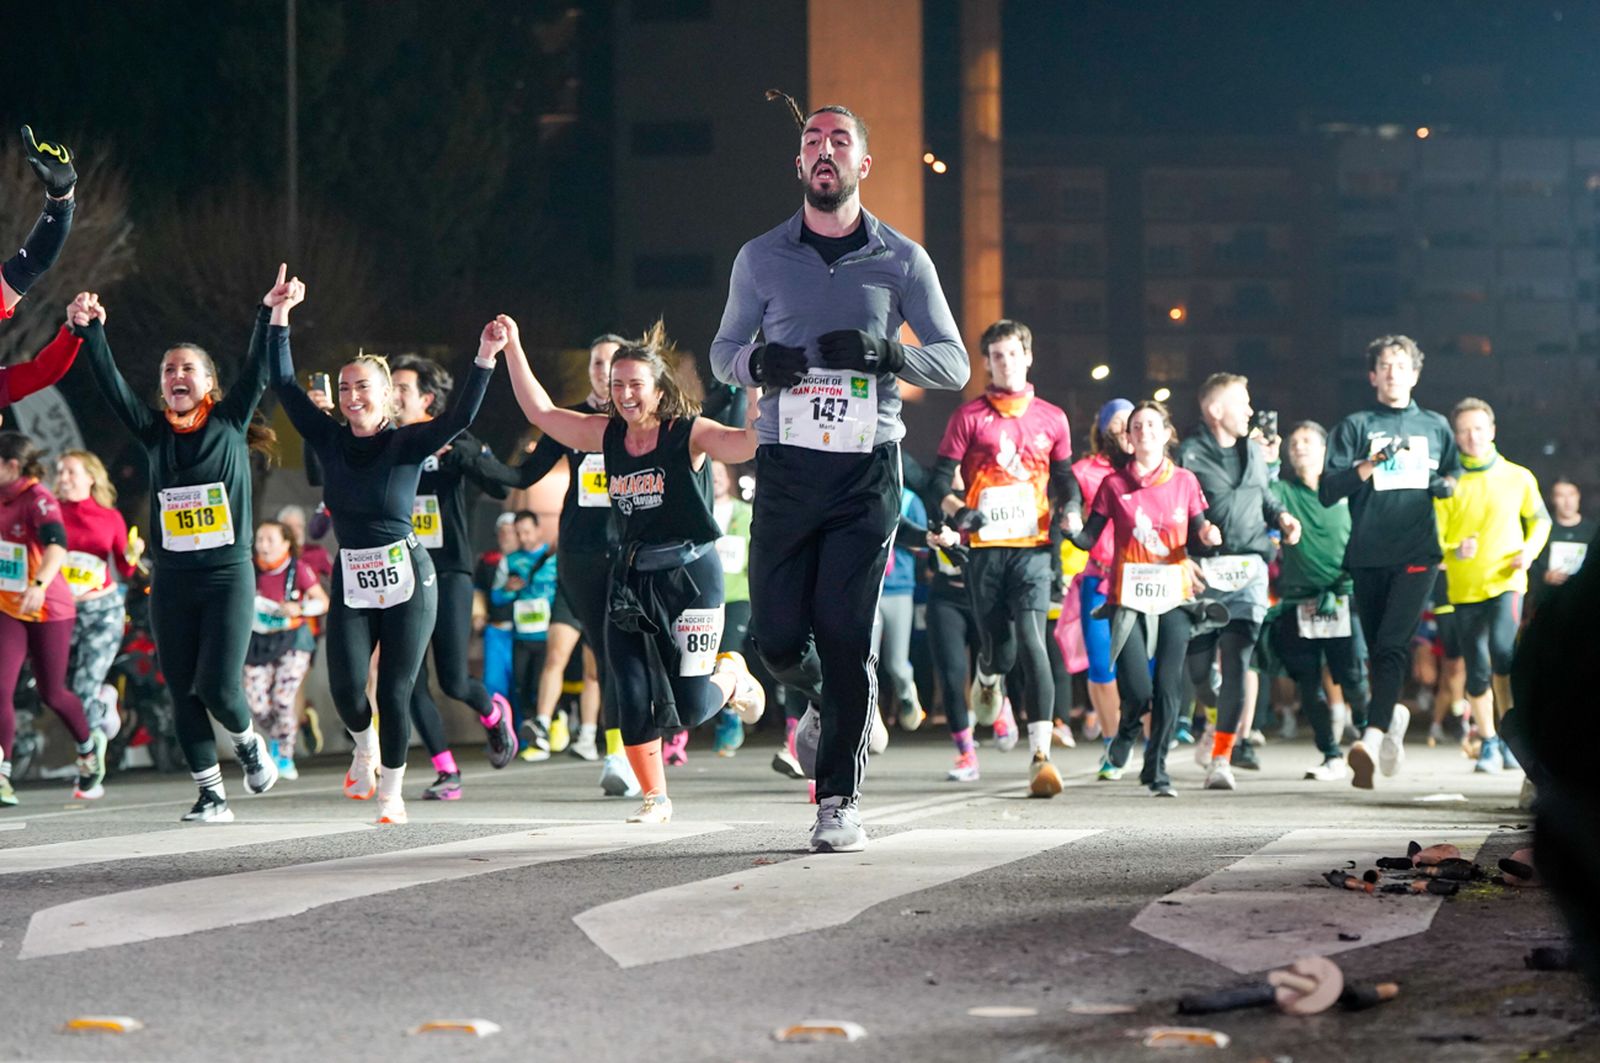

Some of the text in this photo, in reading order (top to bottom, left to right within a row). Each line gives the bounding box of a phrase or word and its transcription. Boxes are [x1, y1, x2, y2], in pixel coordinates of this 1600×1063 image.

[792, 386, 810, 395] SAN
[802, 376, 842, 386] NOCHE DE
[810, 397, 848, 423] 147
[175, 507, 216, 529] 1518
[356, 566, 399, 589] 6315
[687, 632, 718, 653] 896
